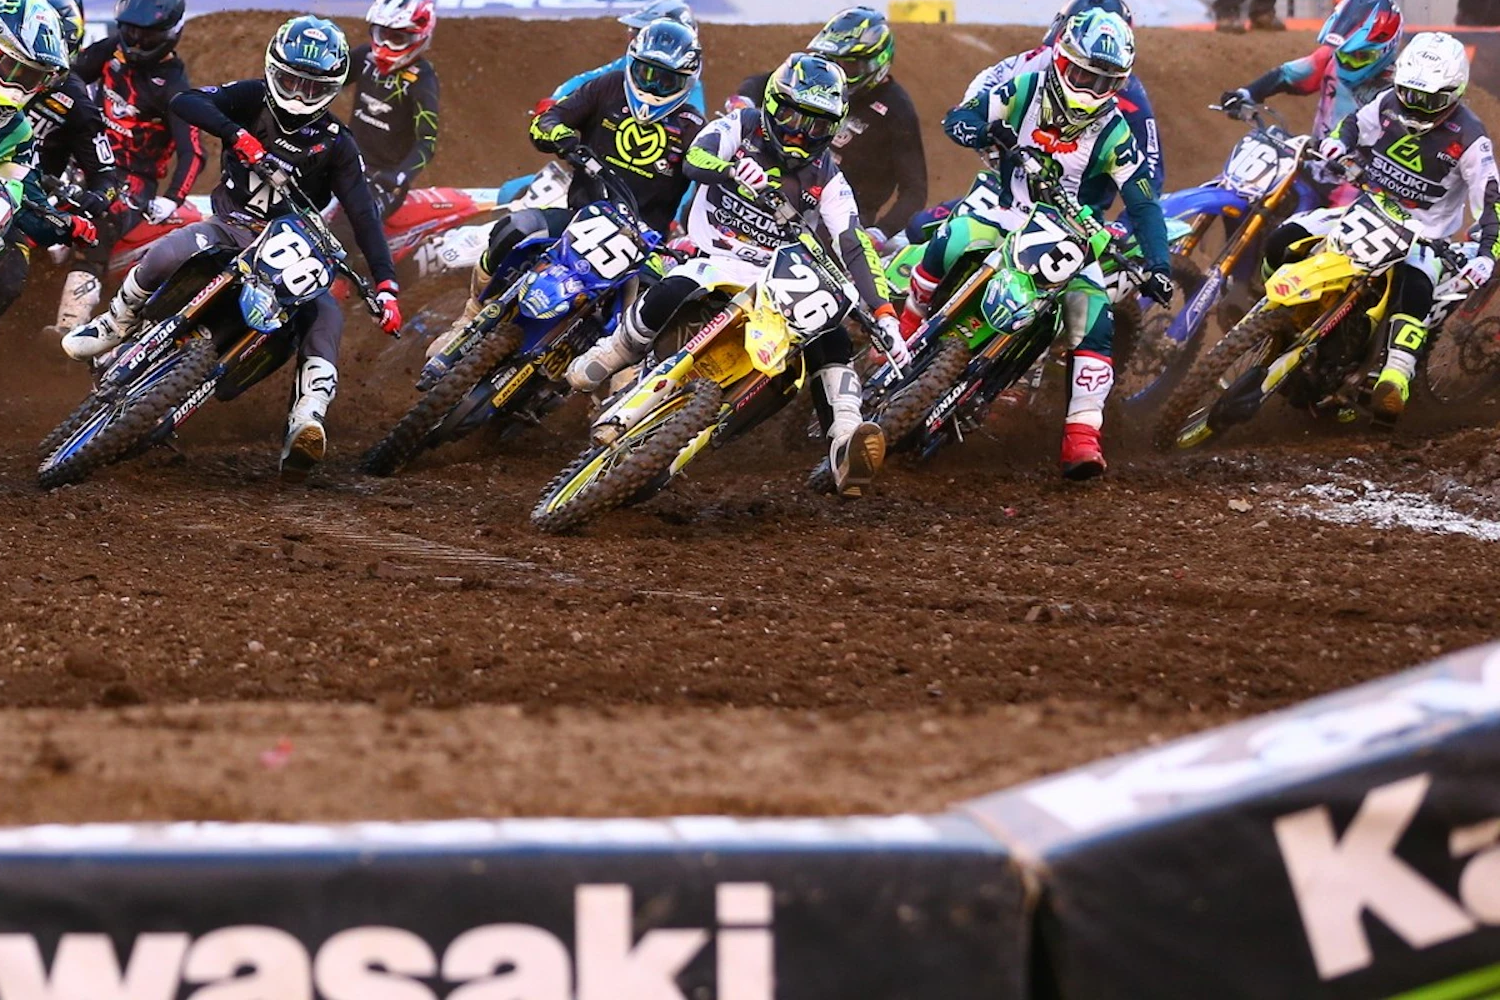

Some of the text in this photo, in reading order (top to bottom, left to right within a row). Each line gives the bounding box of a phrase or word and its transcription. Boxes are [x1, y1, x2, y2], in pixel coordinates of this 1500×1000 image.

[1371, 156, 1430, 192] SUZUKI
[259, 230, 331, 298] 66
[566, 212, 646, 280] 45
[1014, 213, 1085, 284] 73
[1339, 204, 1409, 268] 55
[773, 262, 840, 335] 26
